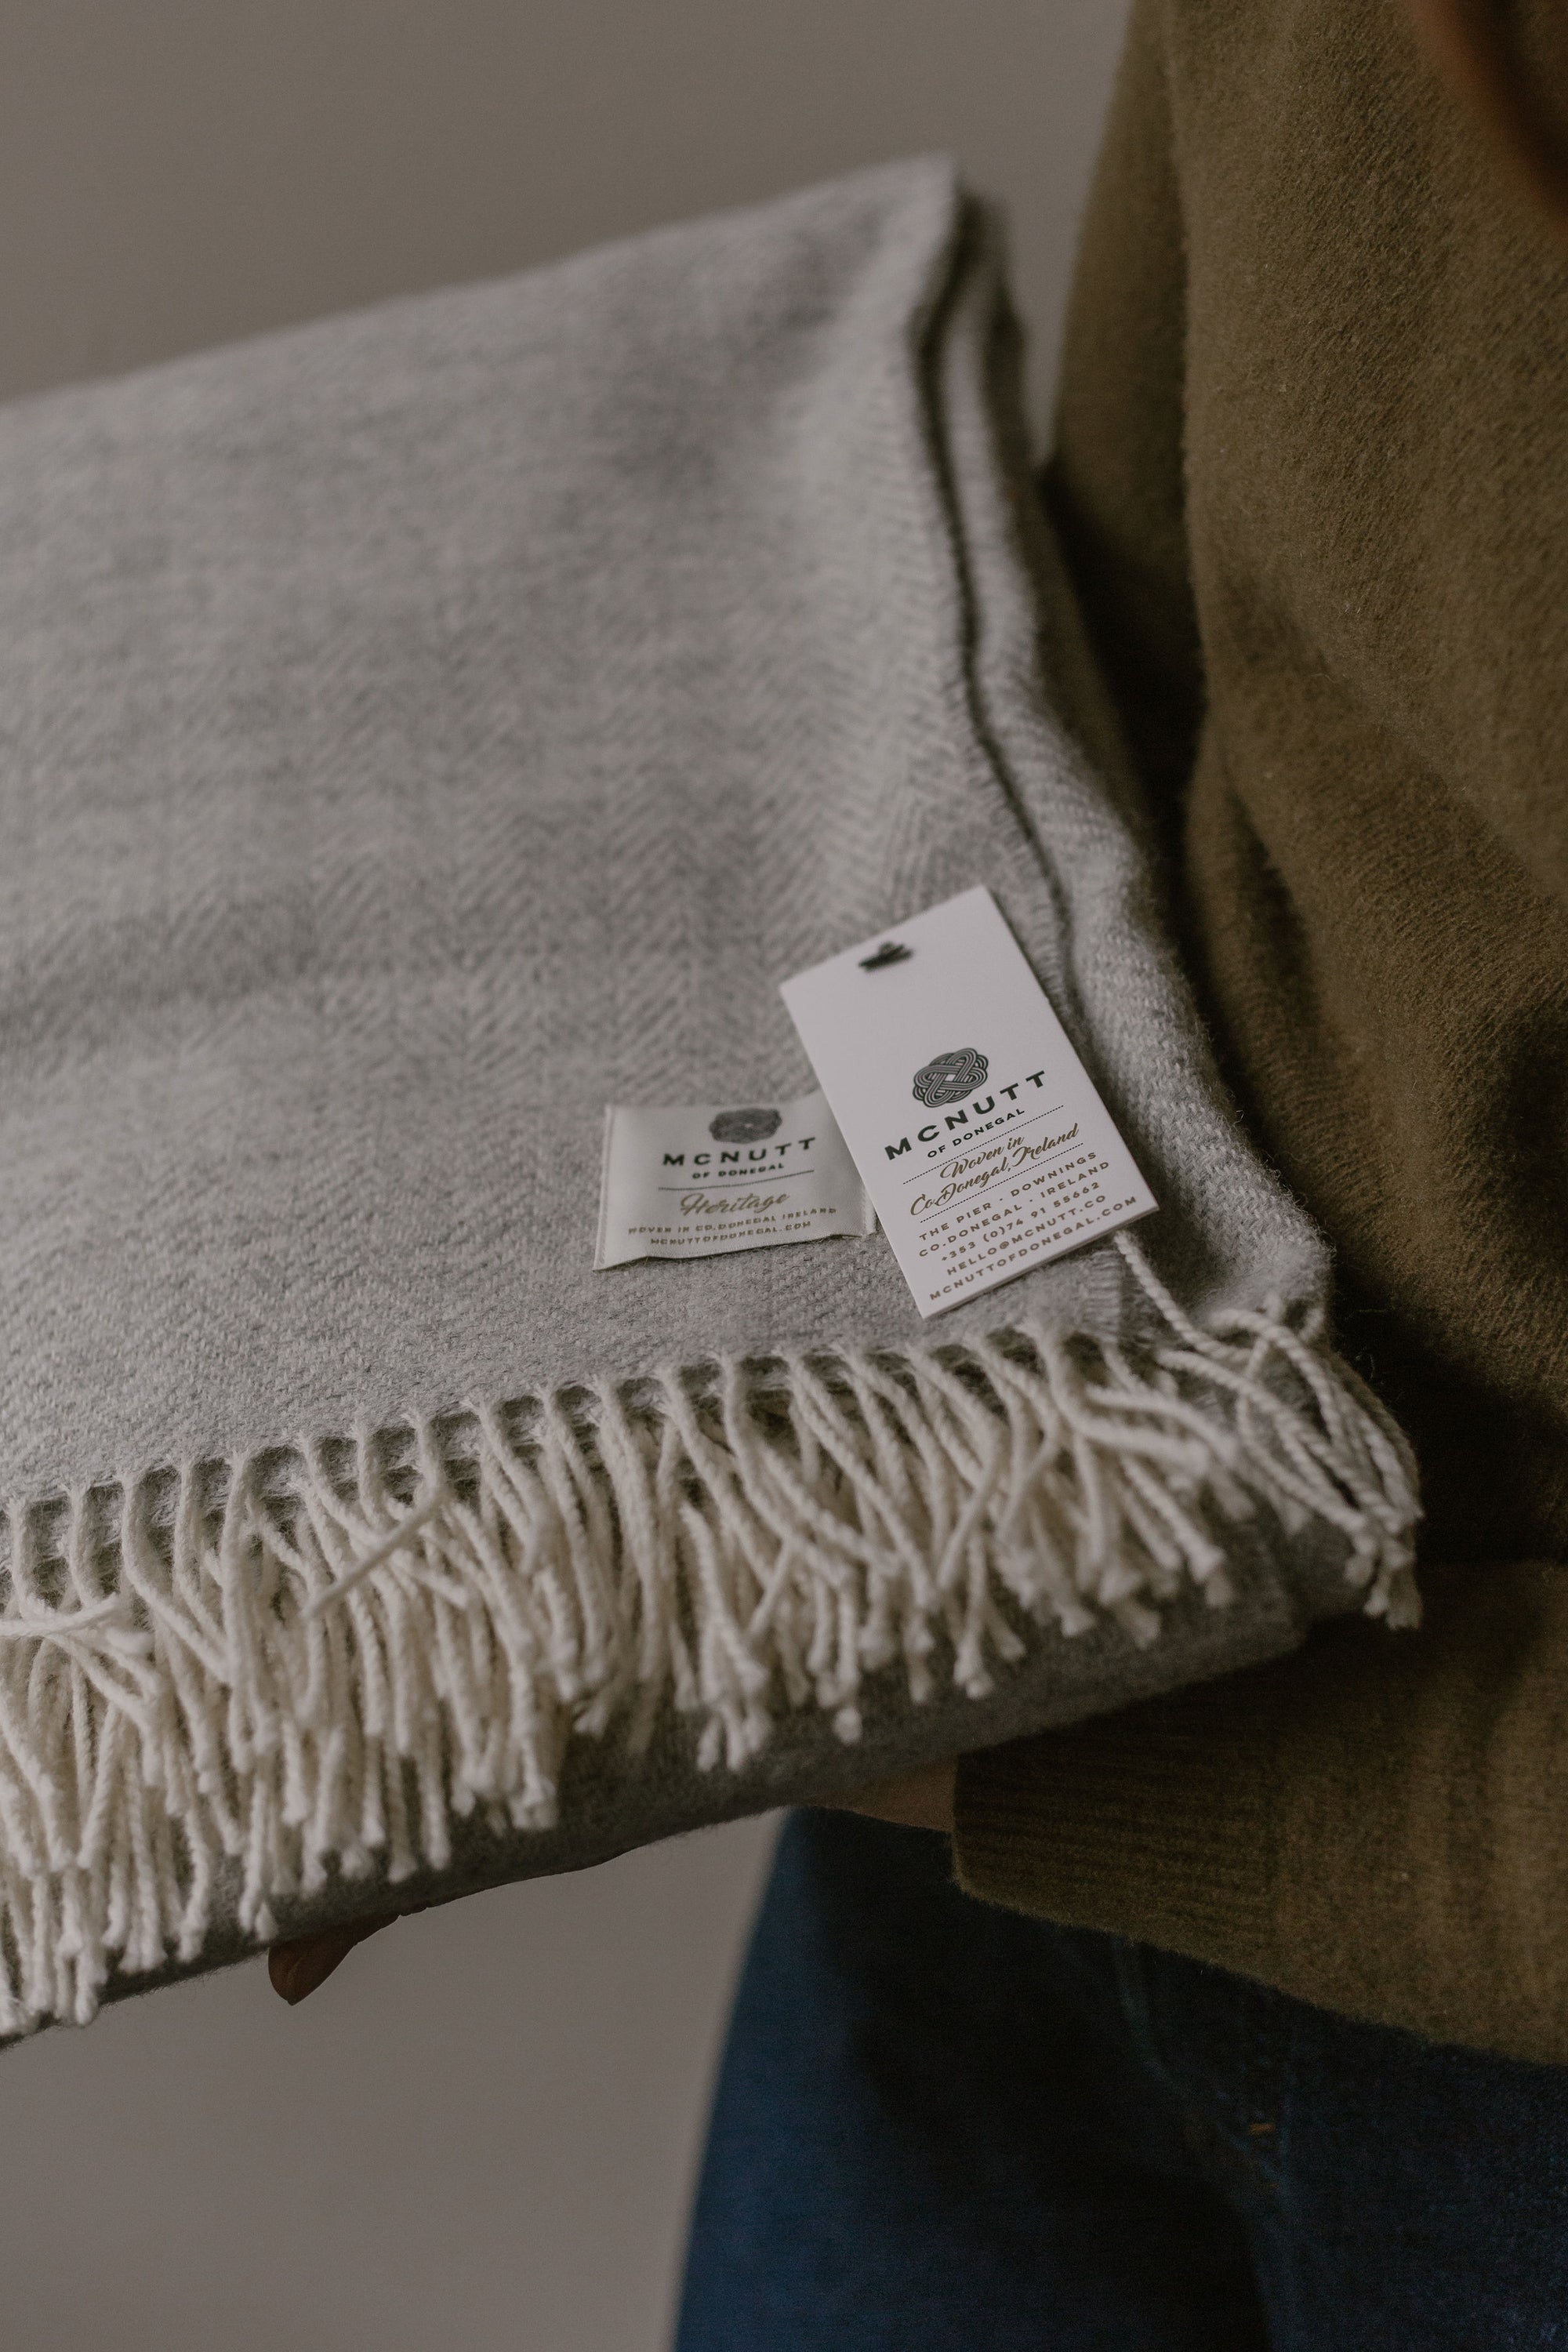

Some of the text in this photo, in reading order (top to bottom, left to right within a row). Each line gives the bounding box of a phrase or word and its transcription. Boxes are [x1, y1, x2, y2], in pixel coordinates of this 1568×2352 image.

[884, 1070, 1045, 1160] MCNUTT
[927, 1108, 1025, 1158] OF DONEGAL
[662, 1137, 815, 1167] MCNUTT
[940, 1136, 1024, 1178] Woven in
[1012, 1123, 1079, 1167] Ireland
[718, 1163, 784, 1177] DONEGAL
[1040, 1162, 1109, 1198] IRELAND
[681, 1193, 790, 1216] Heritage
[782, 1207, 837, 1220] IRELAND
[919, 1152, 1097, 1241] THE PIER DOWNINGS
[942, 1181, 1099, 1261] +353 (0)74 91 55662
[947, 1195, 1105, 1276] HELLO@MCNUTT.CO
[929, 1196, 1137, 1301] MCNUTTOFDONEGAL.COM
